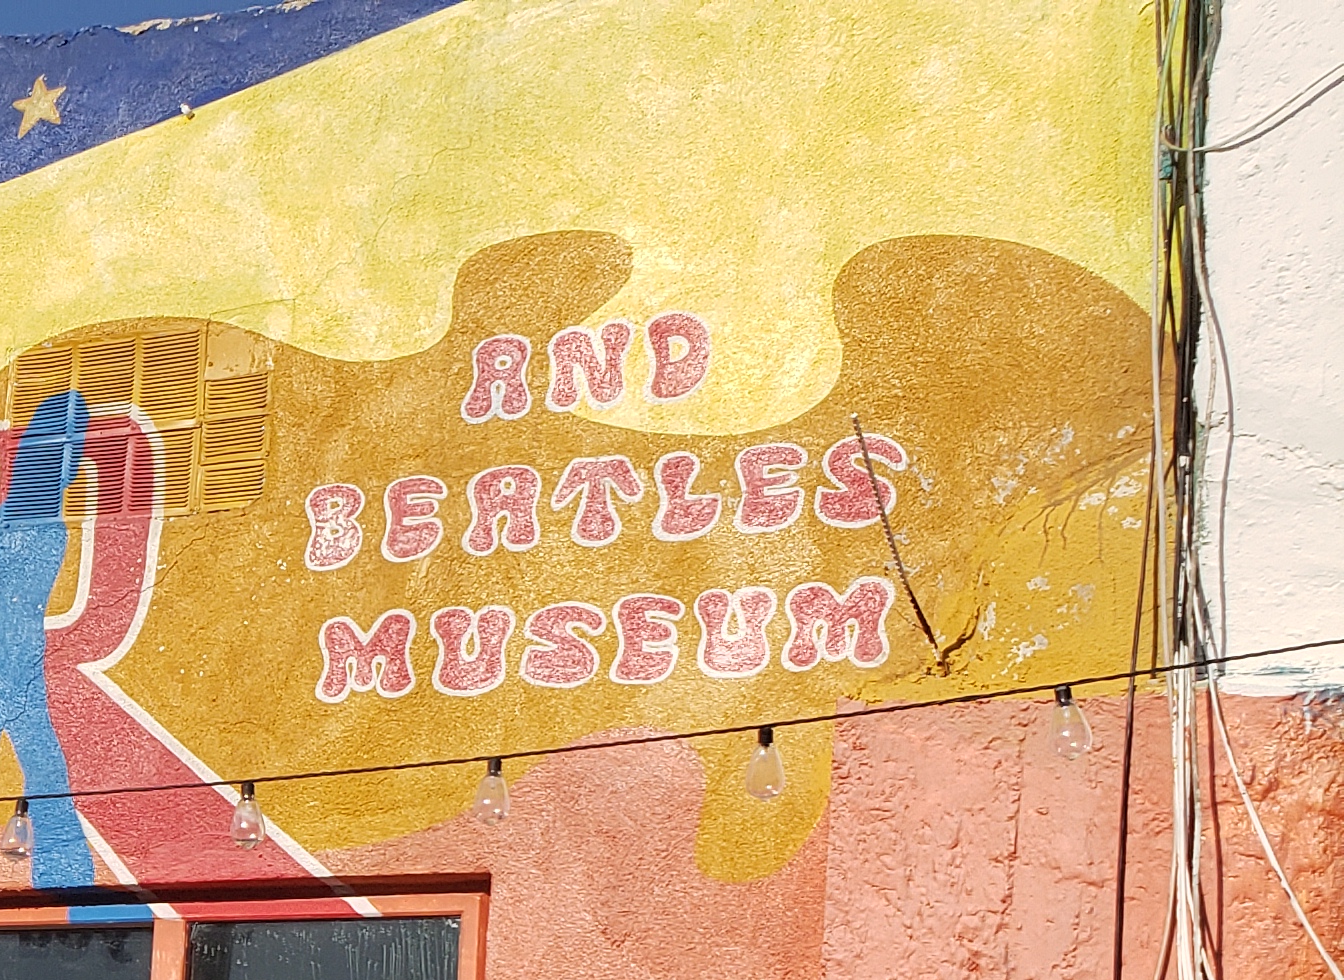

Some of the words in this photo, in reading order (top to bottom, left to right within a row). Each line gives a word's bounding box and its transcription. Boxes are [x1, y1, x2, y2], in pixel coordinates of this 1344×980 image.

[460, 311, 711, 425] AND
[304, 432, 909, 572] BEATLES
[315, 575, 895, 703] MUSEUM
